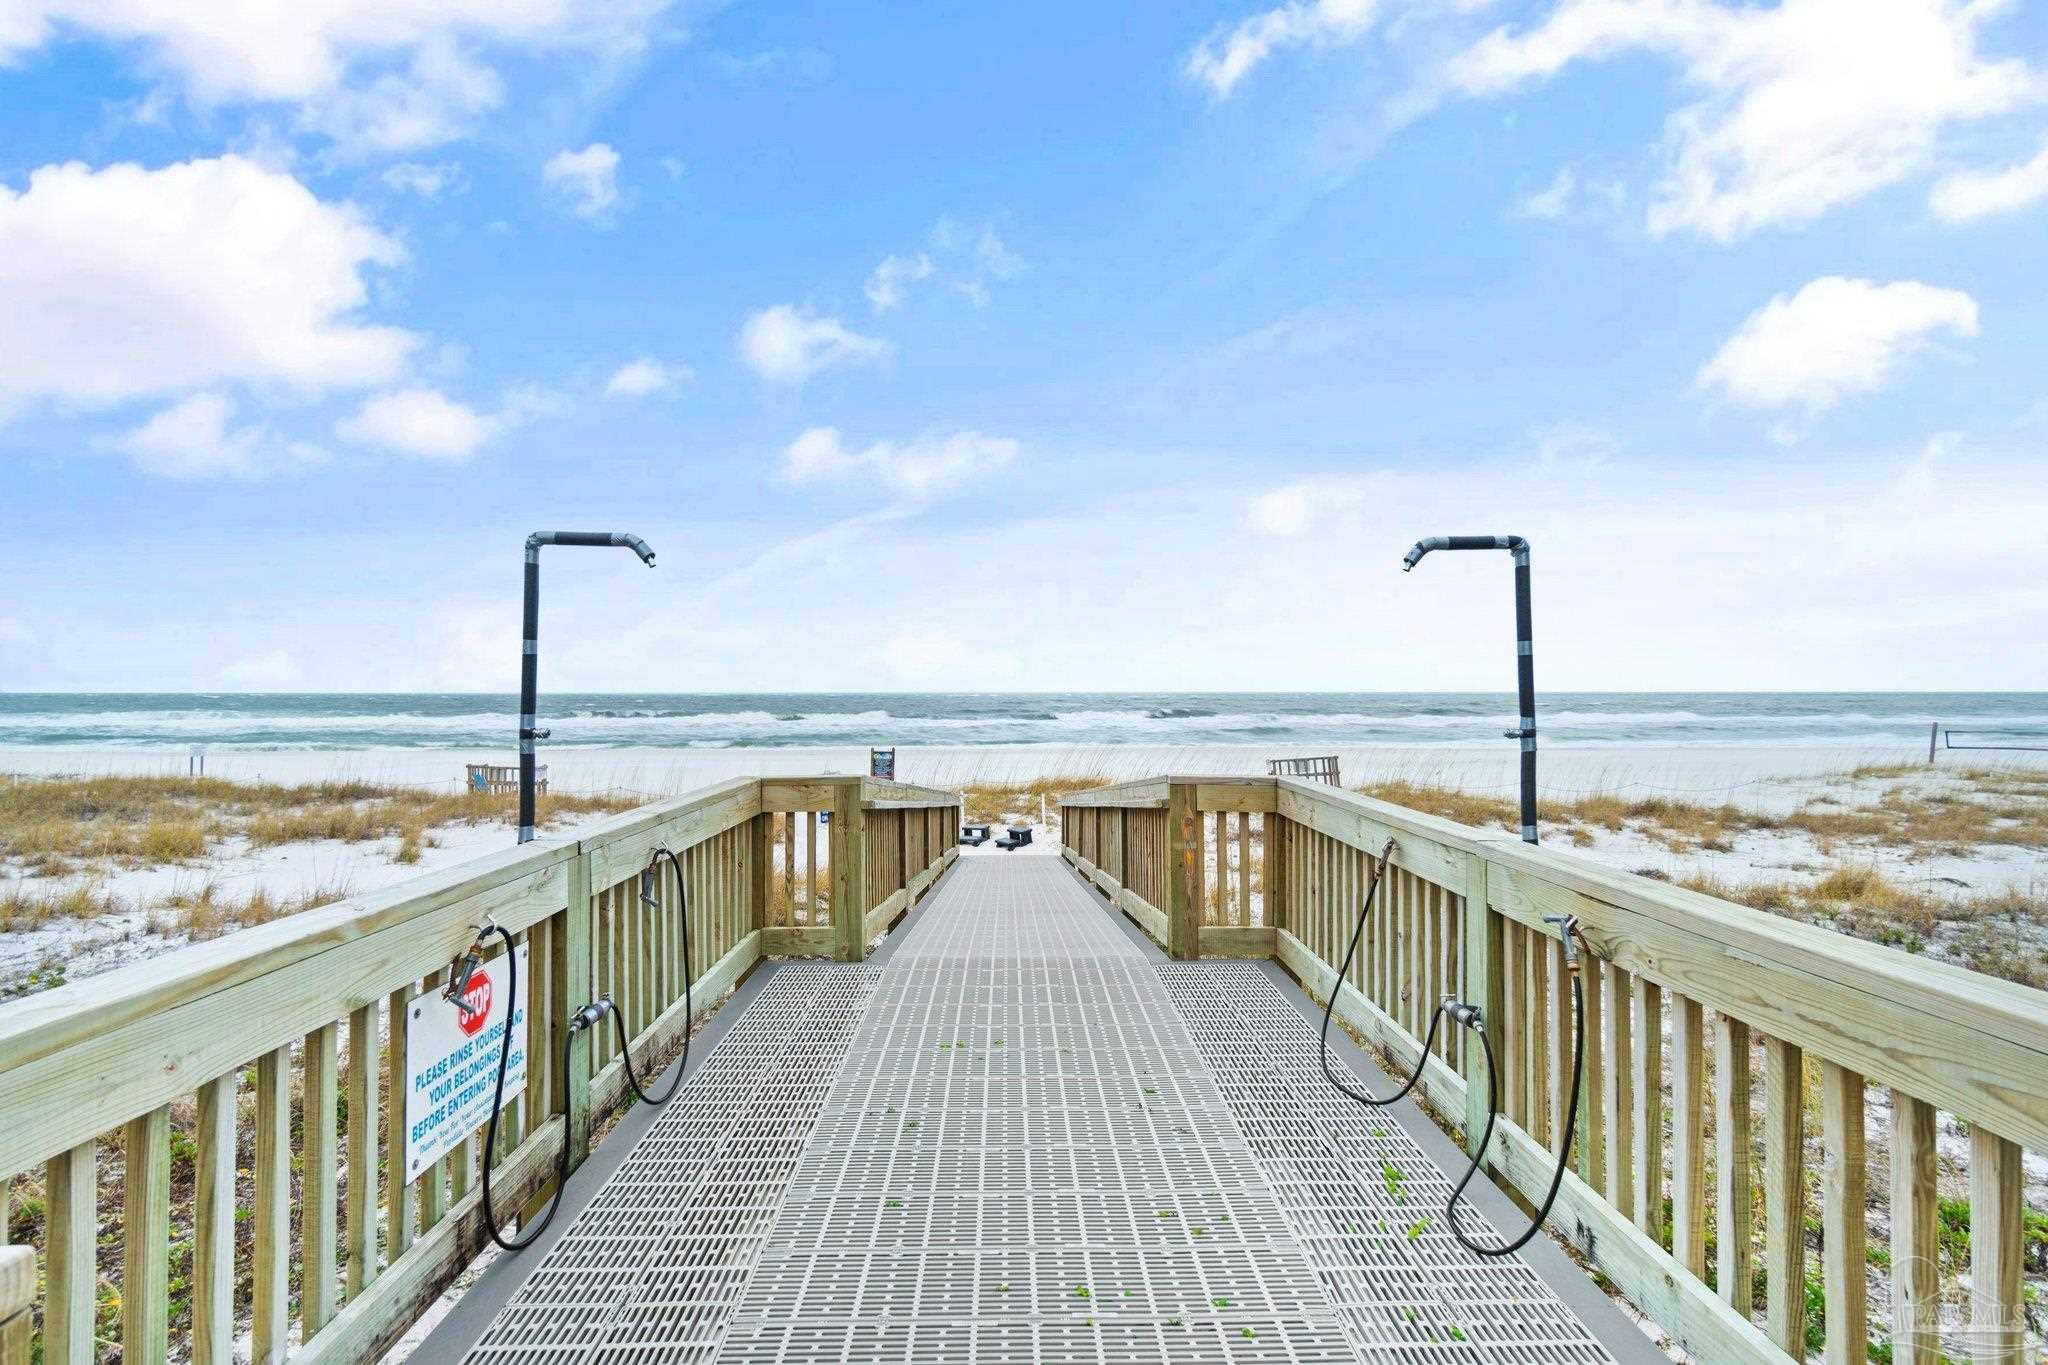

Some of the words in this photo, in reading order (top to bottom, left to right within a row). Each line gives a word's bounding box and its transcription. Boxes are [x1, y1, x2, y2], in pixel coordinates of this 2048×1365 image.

[461, 981, 490, 1026] STOP
[415, 1058, 447, 1092] PLEASE
[450, 1042, 473, 1069] RINSE
[475, 1019, 506, 1052] YOURSEL
[429, 1077, 452, 1106] YOUR
[454, 1045, 500, 1089] BELONGINGS
[412, 1105, 445, 1143] BEFORE
[448, 1076, 486, 1116] ENTERING
